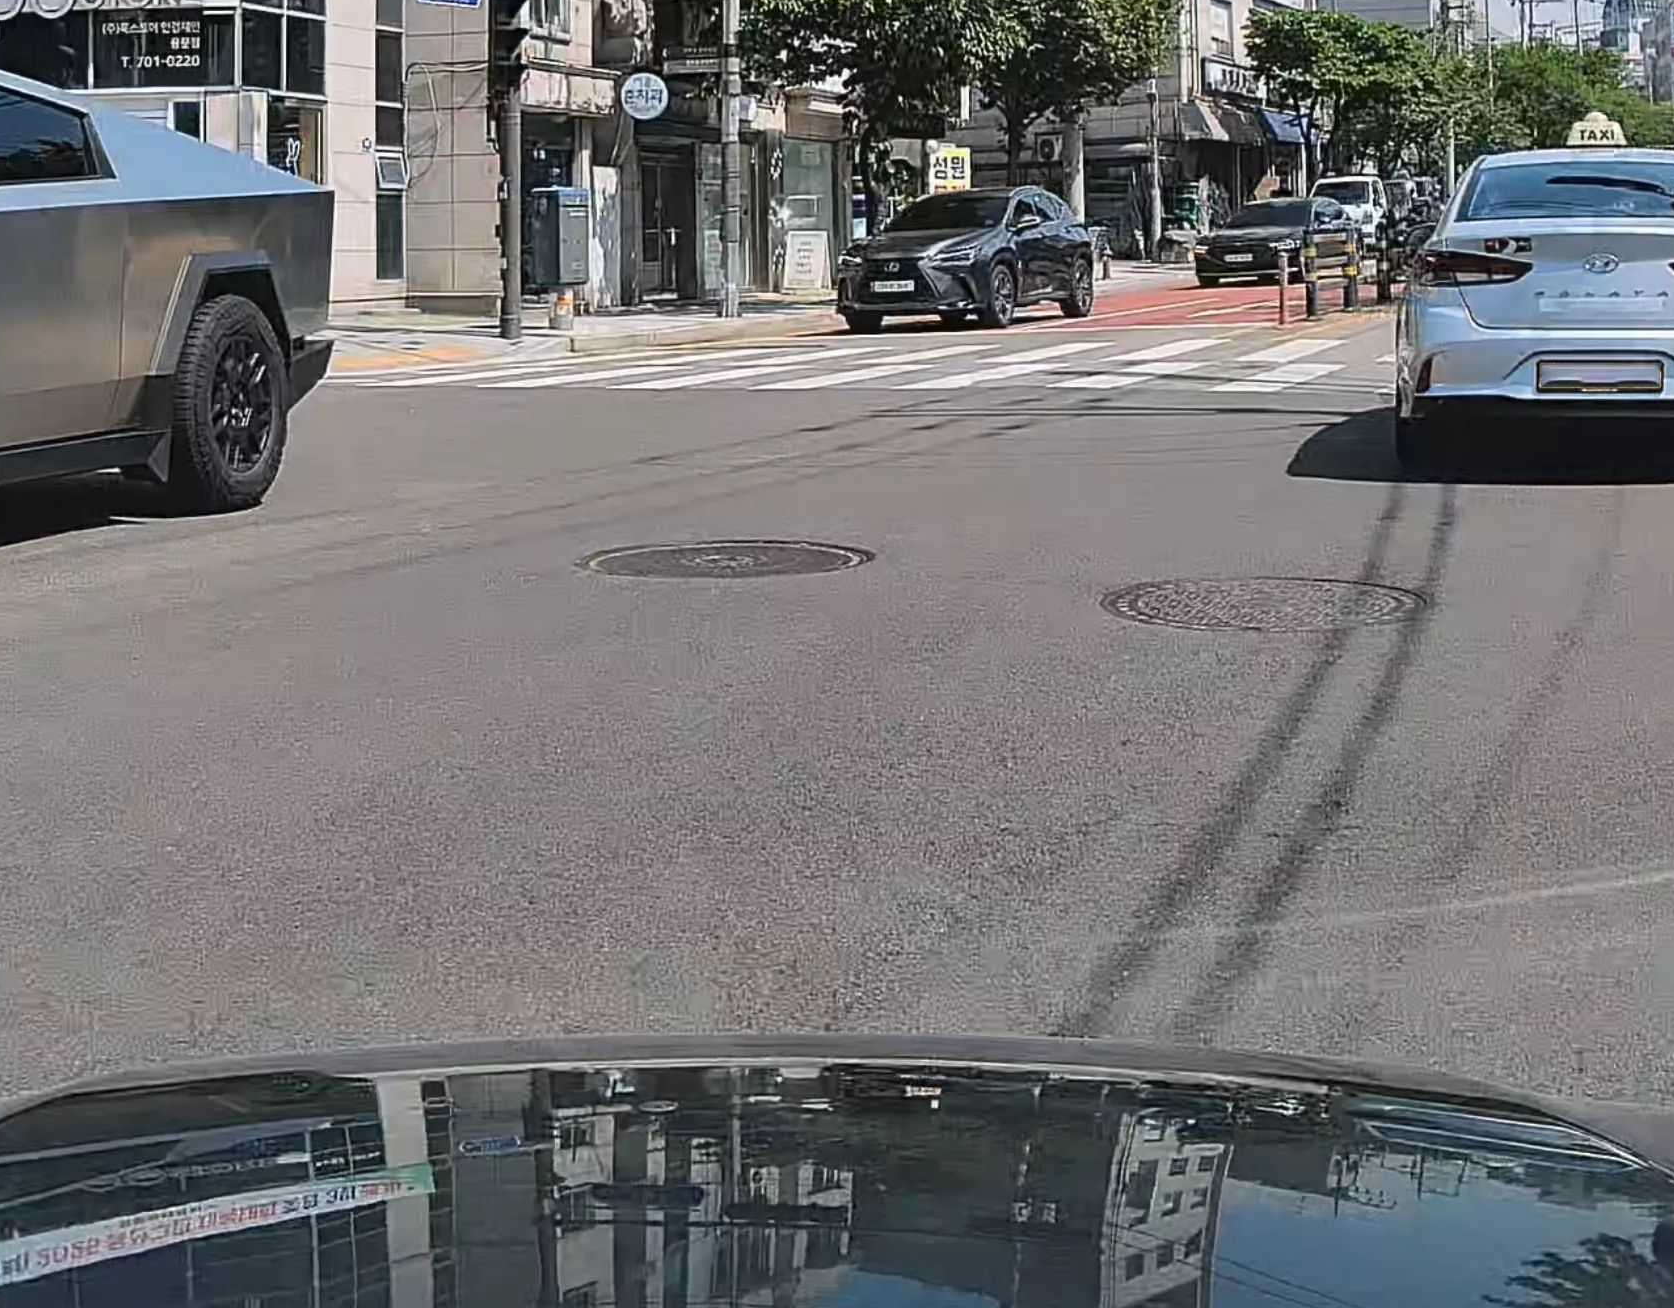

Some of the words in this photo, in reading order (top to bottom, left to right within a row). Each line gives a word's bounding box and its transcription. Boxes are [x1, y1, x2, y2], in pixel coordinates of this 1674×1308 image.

[136, 55, 201, 69] 701-0220
[1579, 130, 1615, 141] TAXI
[933, 155, 966, 180] 성원
